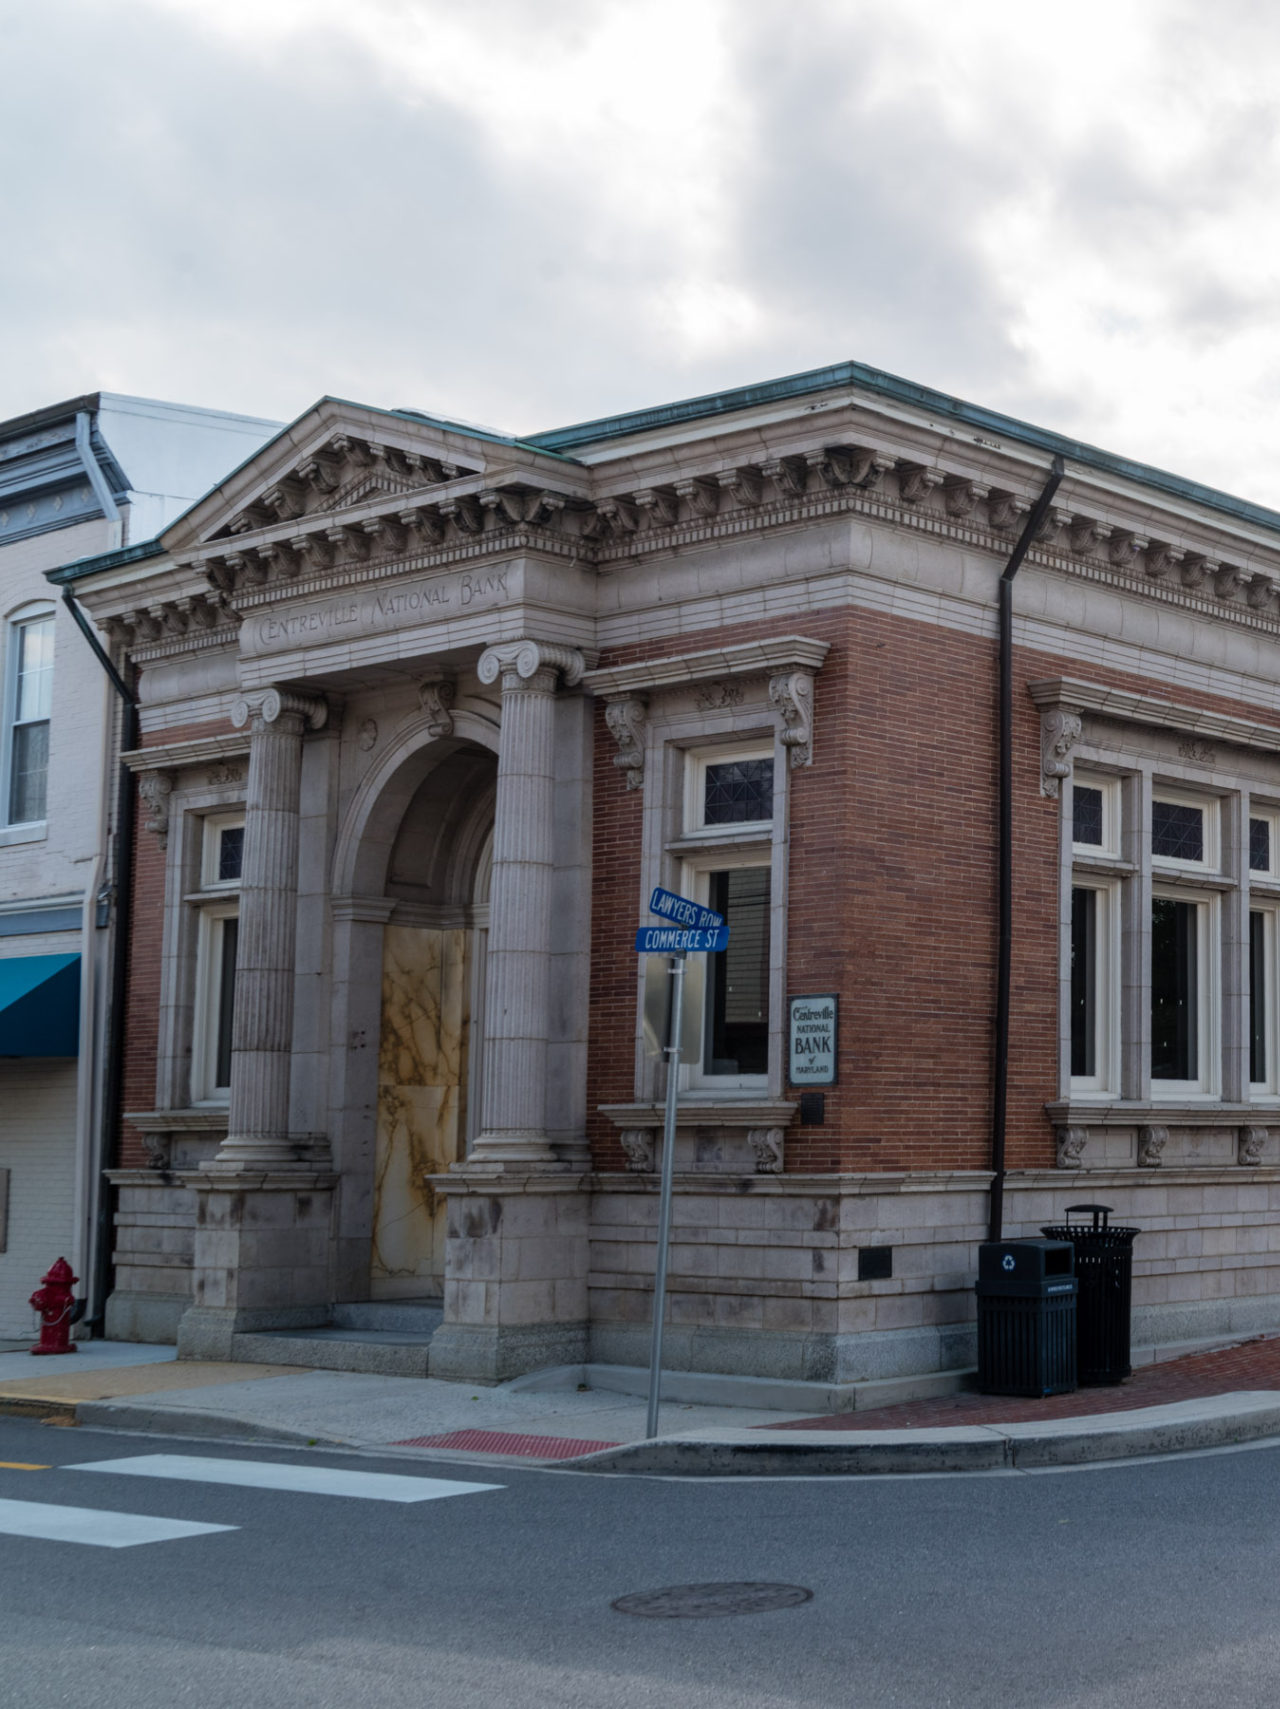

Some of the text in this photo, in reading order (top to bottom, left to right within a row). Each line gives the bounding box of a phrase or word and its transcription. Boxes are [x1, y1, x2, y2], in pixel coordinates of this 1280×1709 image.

[651, 890, 698, 925] LAWYERS
[645, 929, 720, 949] COMMERCE ST
[796, 1023, 831, 1034] NATIONAL
[795, 1036, 831, 1054] BANK
